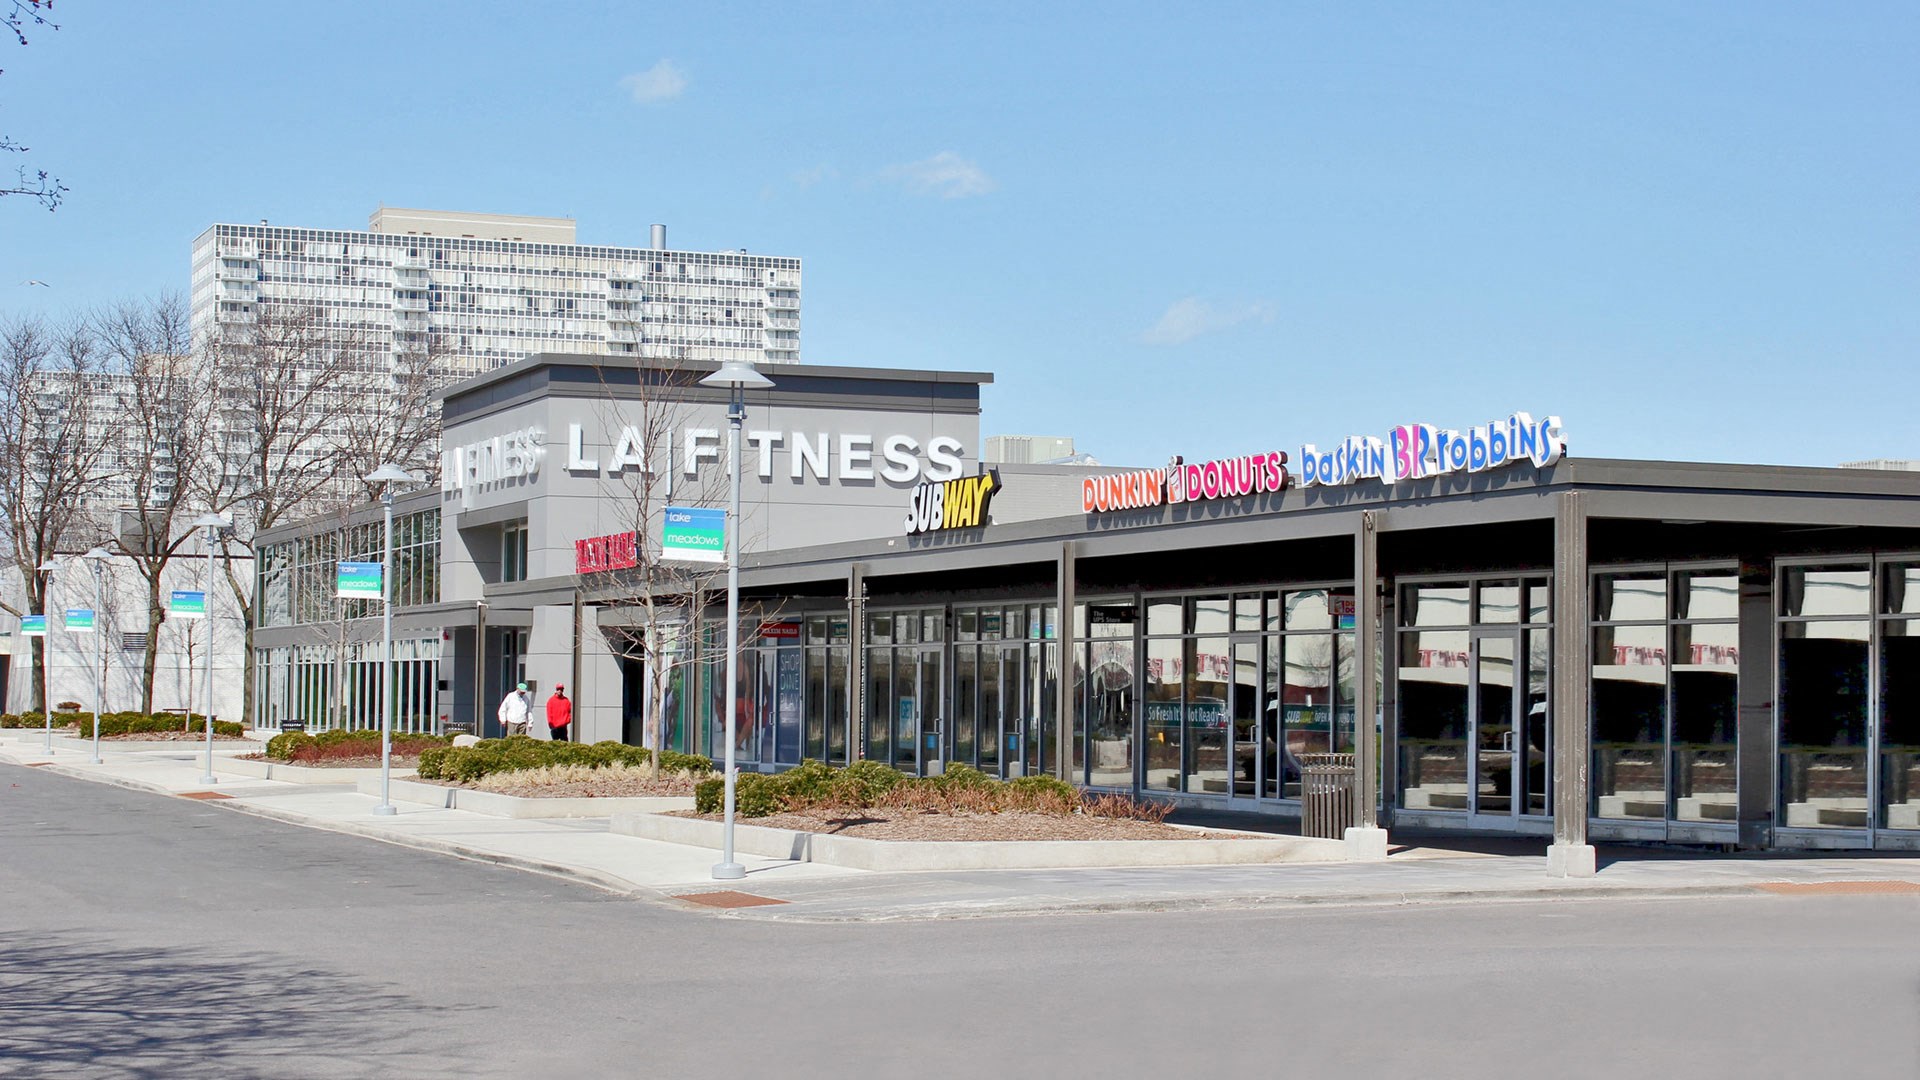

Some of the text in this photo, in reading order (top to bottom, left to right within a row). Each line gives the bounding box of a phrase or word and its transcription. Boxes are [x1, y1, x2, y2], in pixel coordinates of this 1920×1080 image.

[568, 423, 655, 473] LA
[1301, 414, 1556, 487] baskin BR robbins
[1082, 451, 1284, 513] DUNKIN' DONUTS
[905, 469, 996, 535] SUBWAY
[669, 511, 691, 523] lake
[667, 533, 720, 546] meadows
[340, 580, 378, 588] meadows
[780, 654, 800, 671] SHOP
[780, 673, 799, 690] DINE
[1148, 706, 1155, 720] So
[1156, 706, 1173, 721] Fresh
[1199, 706, 1219, 726] Ready
